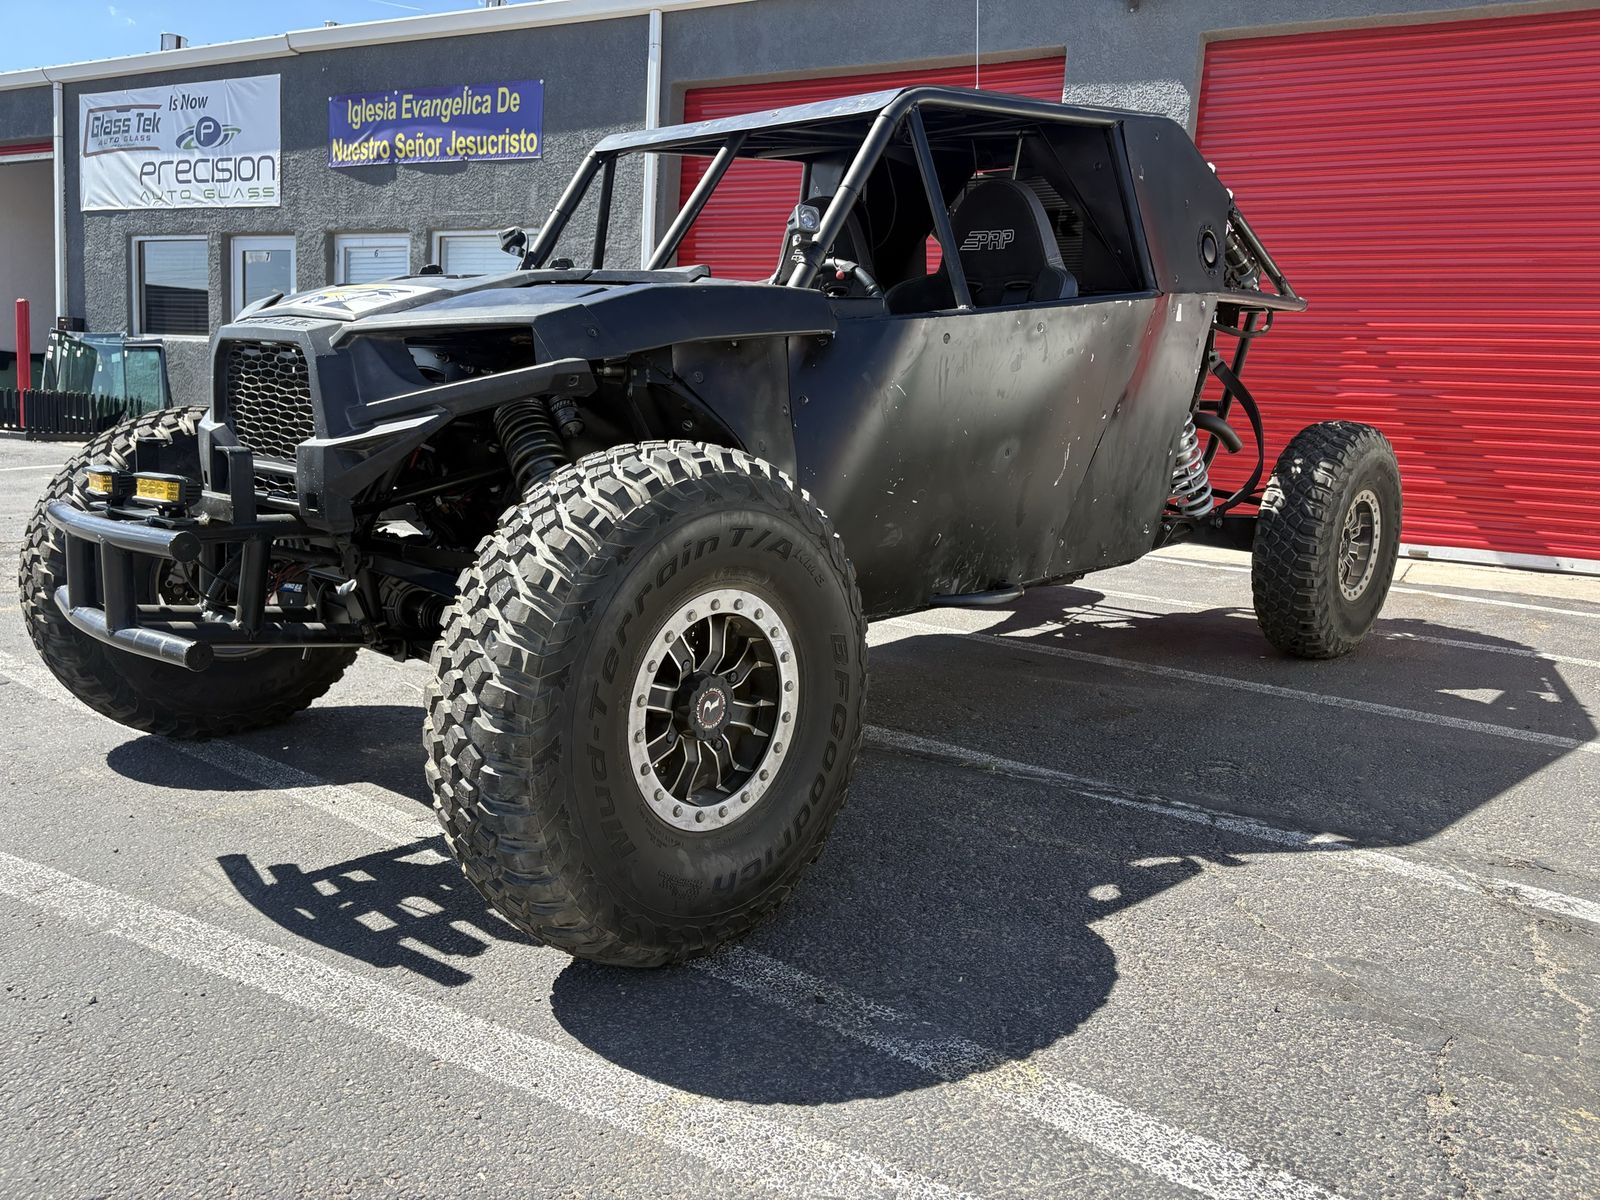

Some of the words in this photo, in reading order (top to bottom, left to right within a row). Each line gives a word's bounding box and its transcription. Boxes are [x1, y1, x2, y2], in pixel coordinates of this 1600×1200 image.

[168, 95, 178, 111] Is
[180, 94, 209, 111] Now
[347, 96, 397, 129] Iglesia
[401, 89, 491, 123] Evangelica
[496, 87, 521, 113] De
[91, 114, 131, 138] Glass
[136, 112, 161, 133] Tek
[97, 136, 120, 146] AUTO
[332, 137, 390, 162] Nuestro
[394, 132, 443, 158] Señor
[446, 128, 538, 156] Jesucristo
[140, 189, 191, 201] AUTO
[203, 187, 275, 199] GLASS
[265, 252, 271, 261] 7
[728, 526, 794, 561] T/A
